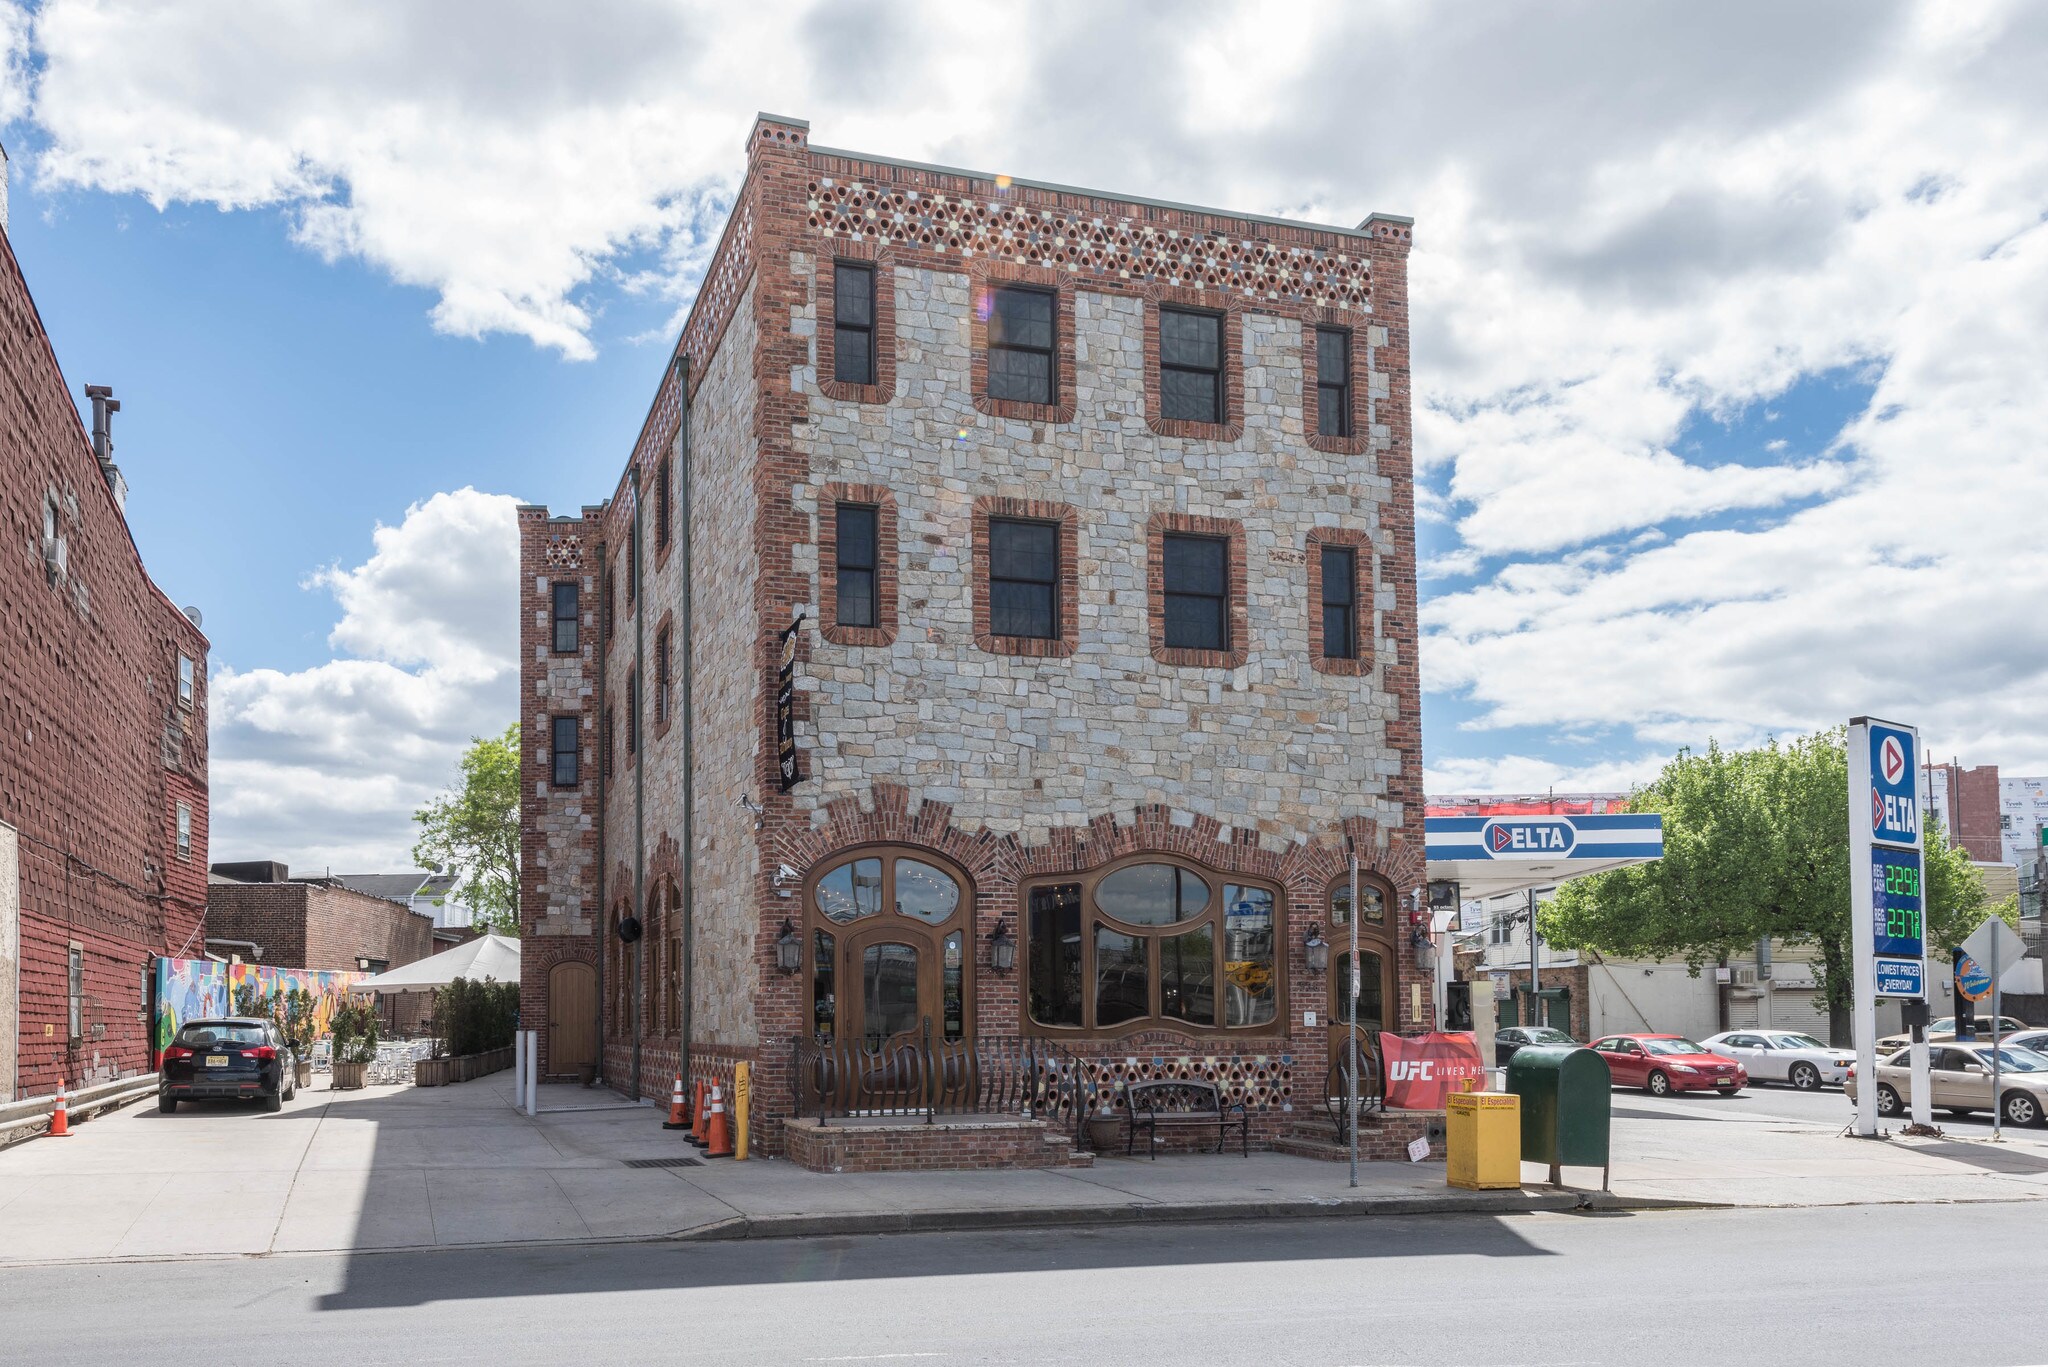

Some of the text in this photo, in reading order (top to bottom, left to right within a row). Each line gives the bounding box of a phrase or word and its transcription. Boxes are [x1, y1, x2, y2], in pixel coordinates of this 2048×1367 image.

[1873, 864, 1885, 878] REG.
[1874, 878, 1886, 892] CASH
[1874, 908, 1886, 922] REG.
[1877, 963, 1920, 977] LOWEST PRICES
[1885, 979, 1913, 990] EVERYDAY
[1390, 1061, 1434, 1081] UFC
[1436, 1067, 1465, 1076] LIVES
